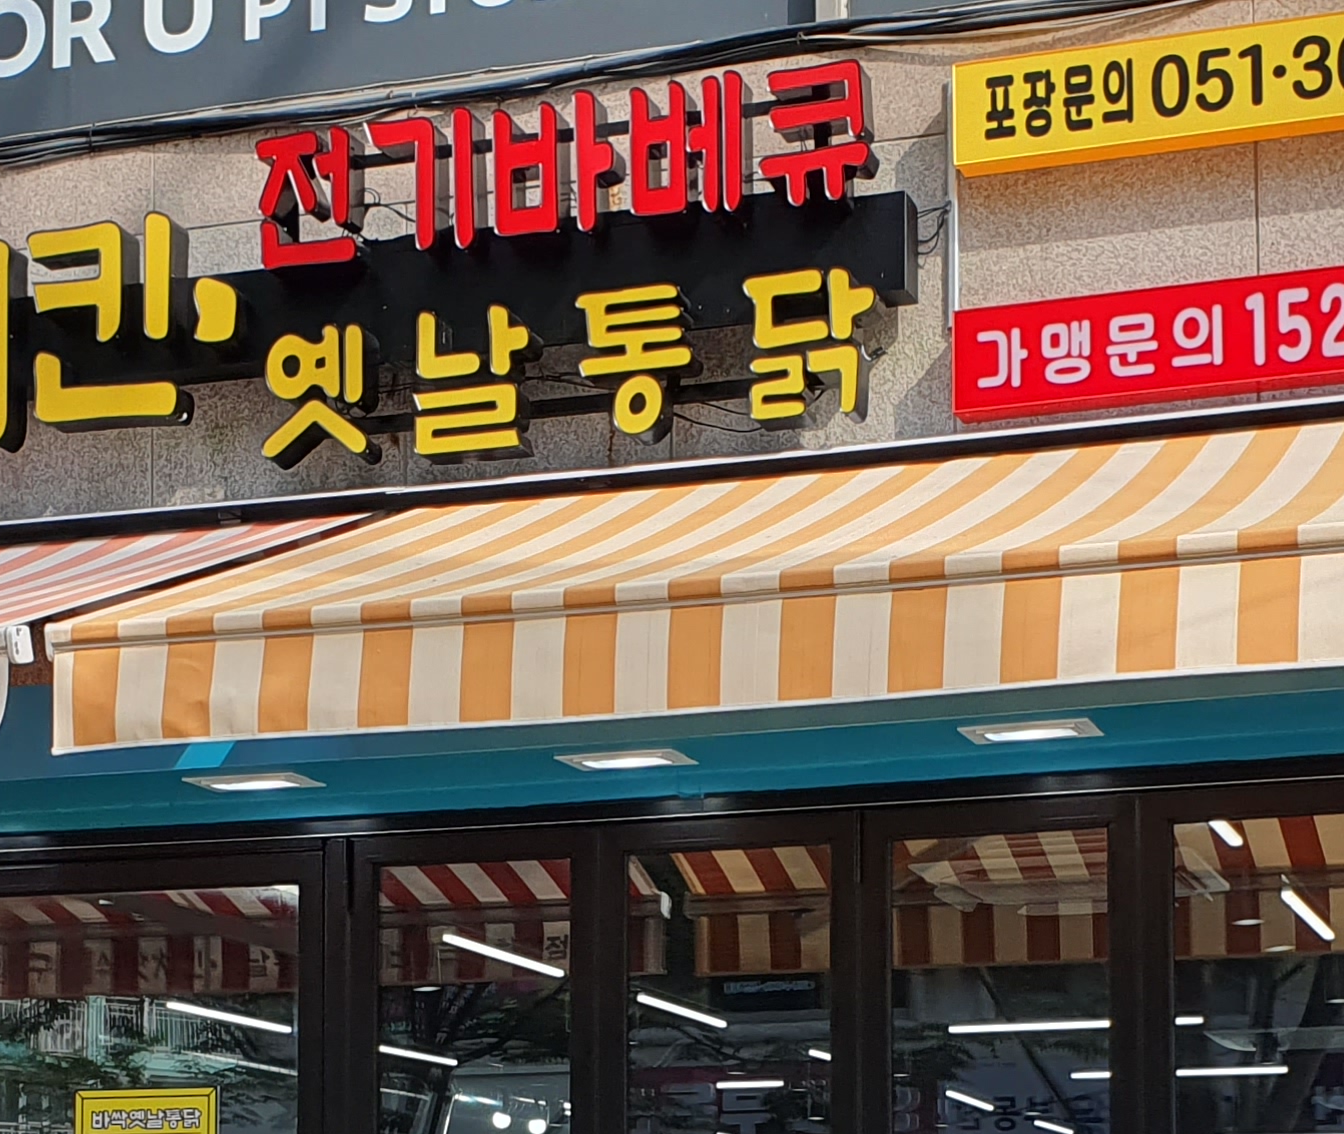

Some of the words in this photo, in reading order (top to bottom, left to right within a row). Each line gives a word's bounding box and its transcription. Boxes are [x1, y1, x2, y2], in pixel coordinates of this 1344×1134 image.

[984, 57, 1135, 142] 포장문의
[254, 60, 869, 270] 전기바베큐
[261, 267, 876, 456] 옛날통닭
[977, 303, 1223, 389] 가맹문의
[90, 1107, 203, 1131] 바싹옛날통닭
